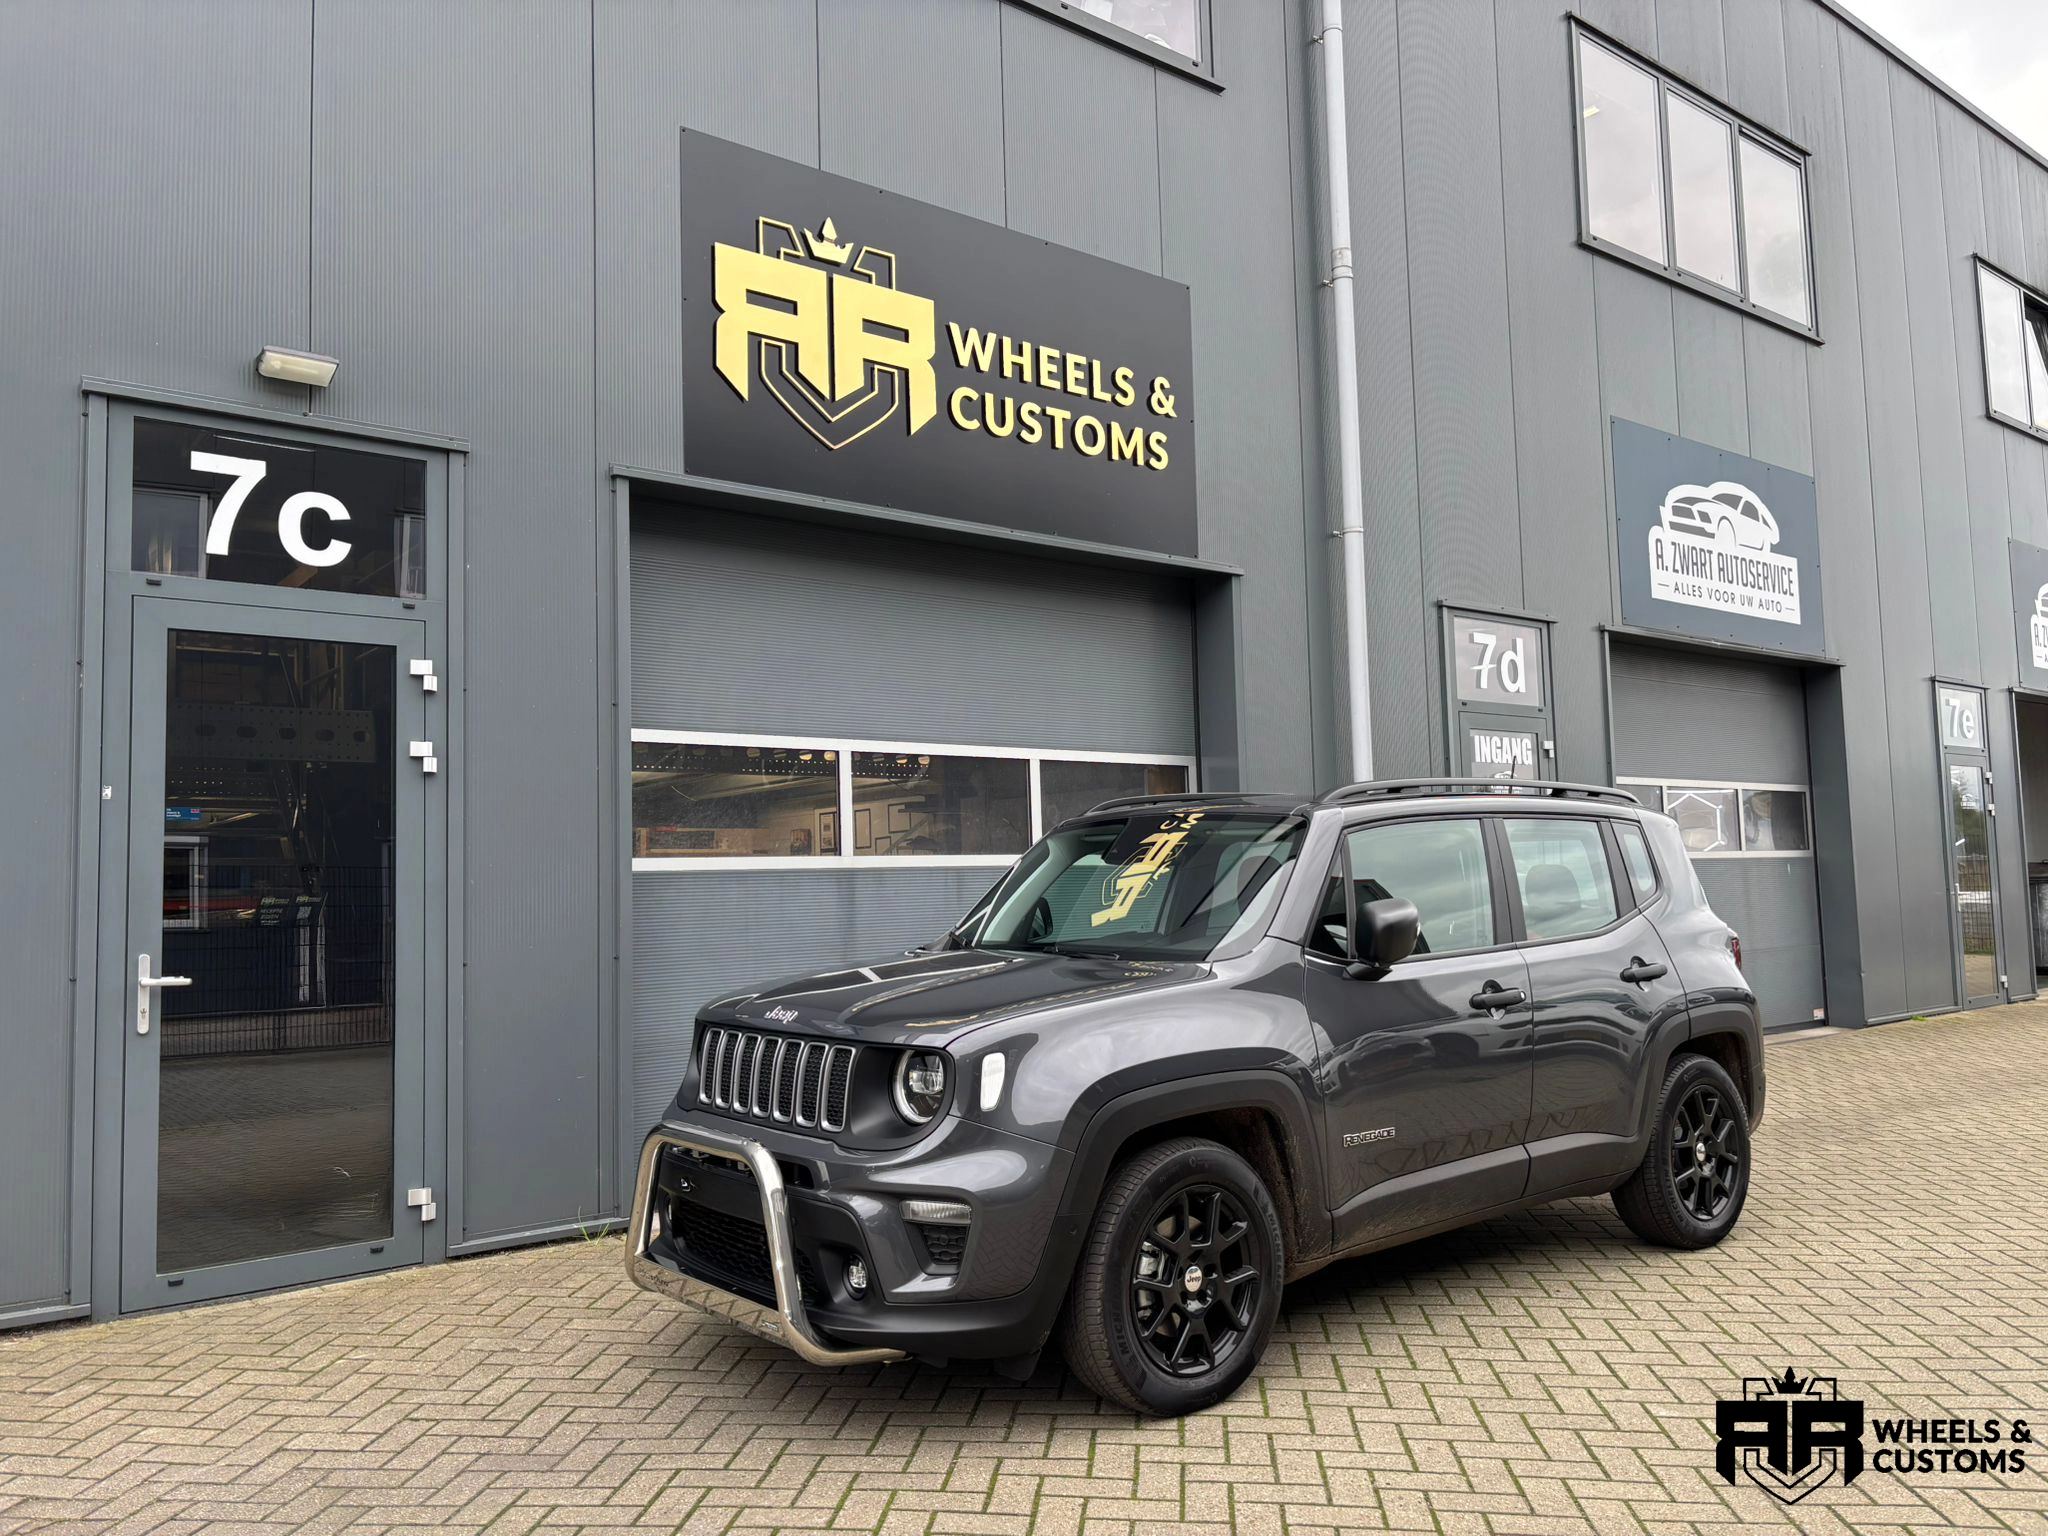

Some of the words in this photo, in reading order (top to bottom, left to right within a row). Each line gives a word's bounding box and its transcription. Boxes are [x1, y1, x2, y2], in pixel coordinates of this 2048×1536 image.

[948, 321, 1136, 408] WHEELS
[1150, 376, 1178, 418] &
[950, 386, 1170, 471] CUSTOMS
[1655, 538, 1669, 571] A.
[1671, 541, 1714, 581] ZWART
[1717, 552, 1795, 597] AUTOSERVICE
[1673, 581, 1703, 598] ALLES
[1707, 587, 1736, 605] VOOR
[1740, 594, 1754, 608] UW
[1758, 598, 1783, 613] AUTO
[1469, 632, 1526, 693] 7d
[1946, 698, 1975, 739] 7e
[1473, 735, 1533, 766] INGANG
[1343, 1127, 1396, 1147] RENEGADE
